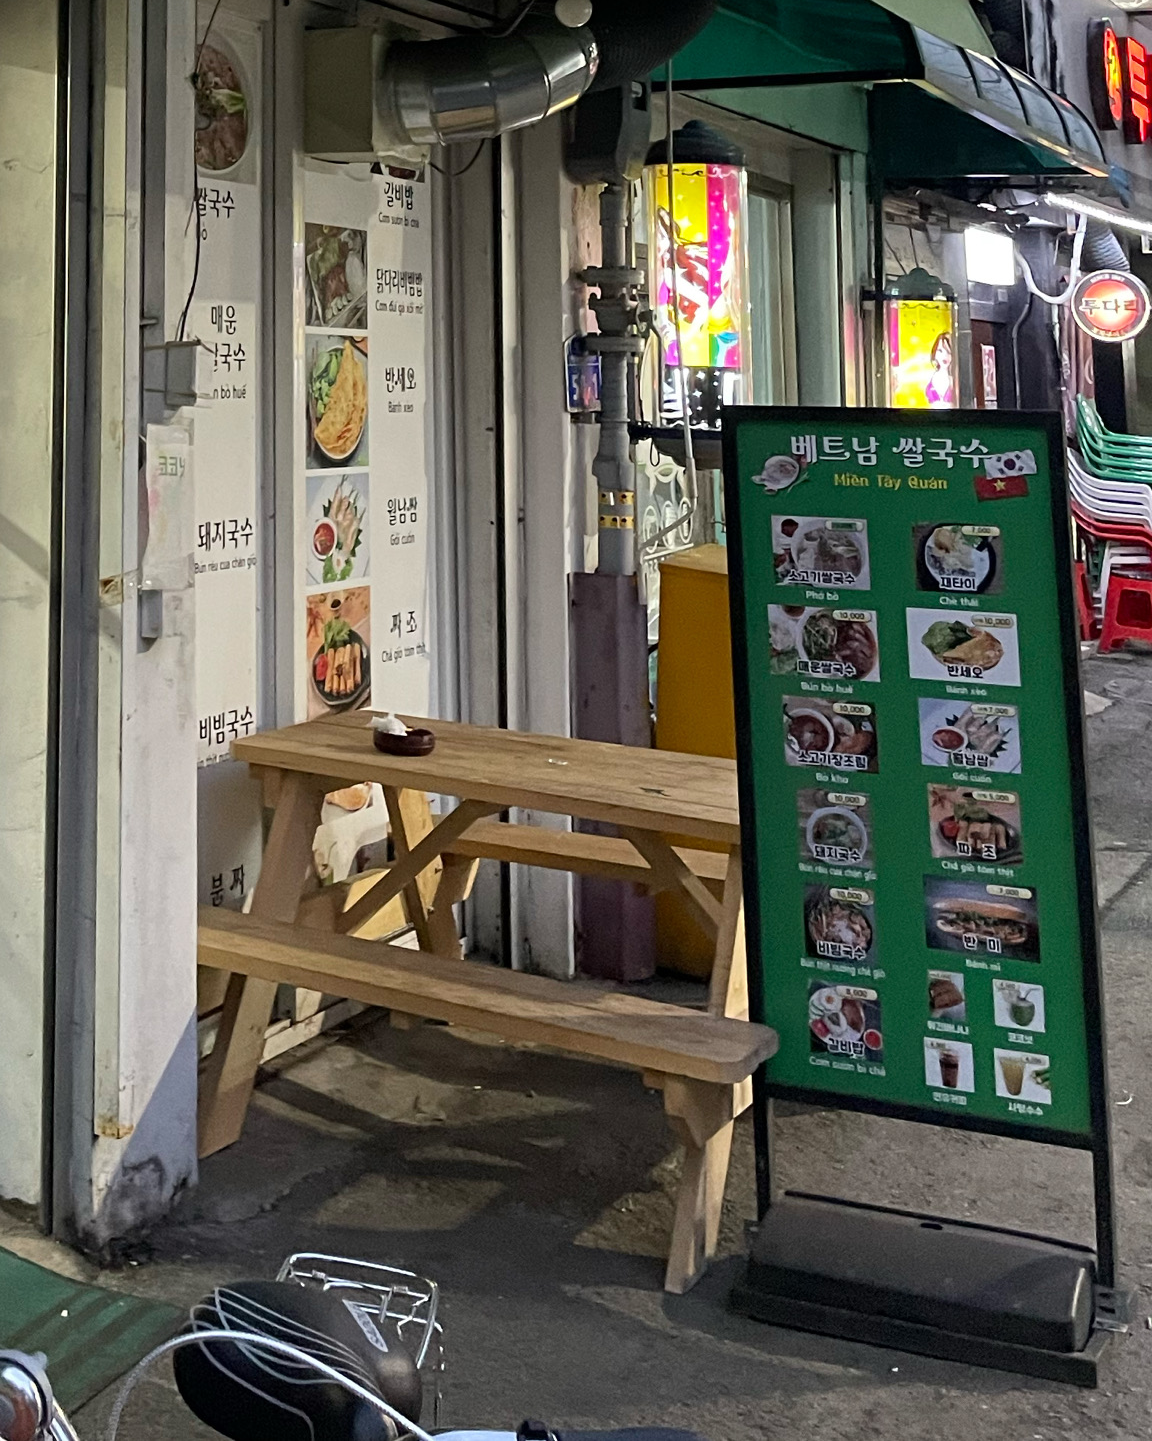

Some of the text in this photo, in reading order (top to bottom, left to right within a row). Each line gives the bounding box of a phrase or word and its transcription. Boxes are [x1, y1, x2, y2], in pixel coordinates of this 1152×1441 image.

[384, 181, 414, 210] 갈비밥
[211, 305, 237, 335] 매운
[385, 366, 416, 393] 반세오
[790, 434, 995, 469] 베트남 쌀국수
[908, 475, 948, 490] Quán
[198, 518, 254, 551] 돼지국수
[787, 570, 857, 586] 소고기쌀국수
[798, 660, 857, 677] 매운쌀국수
[947, 664, 985, 679] 반세오
[199, 706, 254, 746] 비빔국수
[797, 751, 868, 770] 소고기장조림
[814, 844, 863, 863] 돼지국수
[817, 941, 867, 960] 비빔국수
[964, 934, 1002, 953] 반 미
[826, 1037, 865, 1057] 갈비밥
